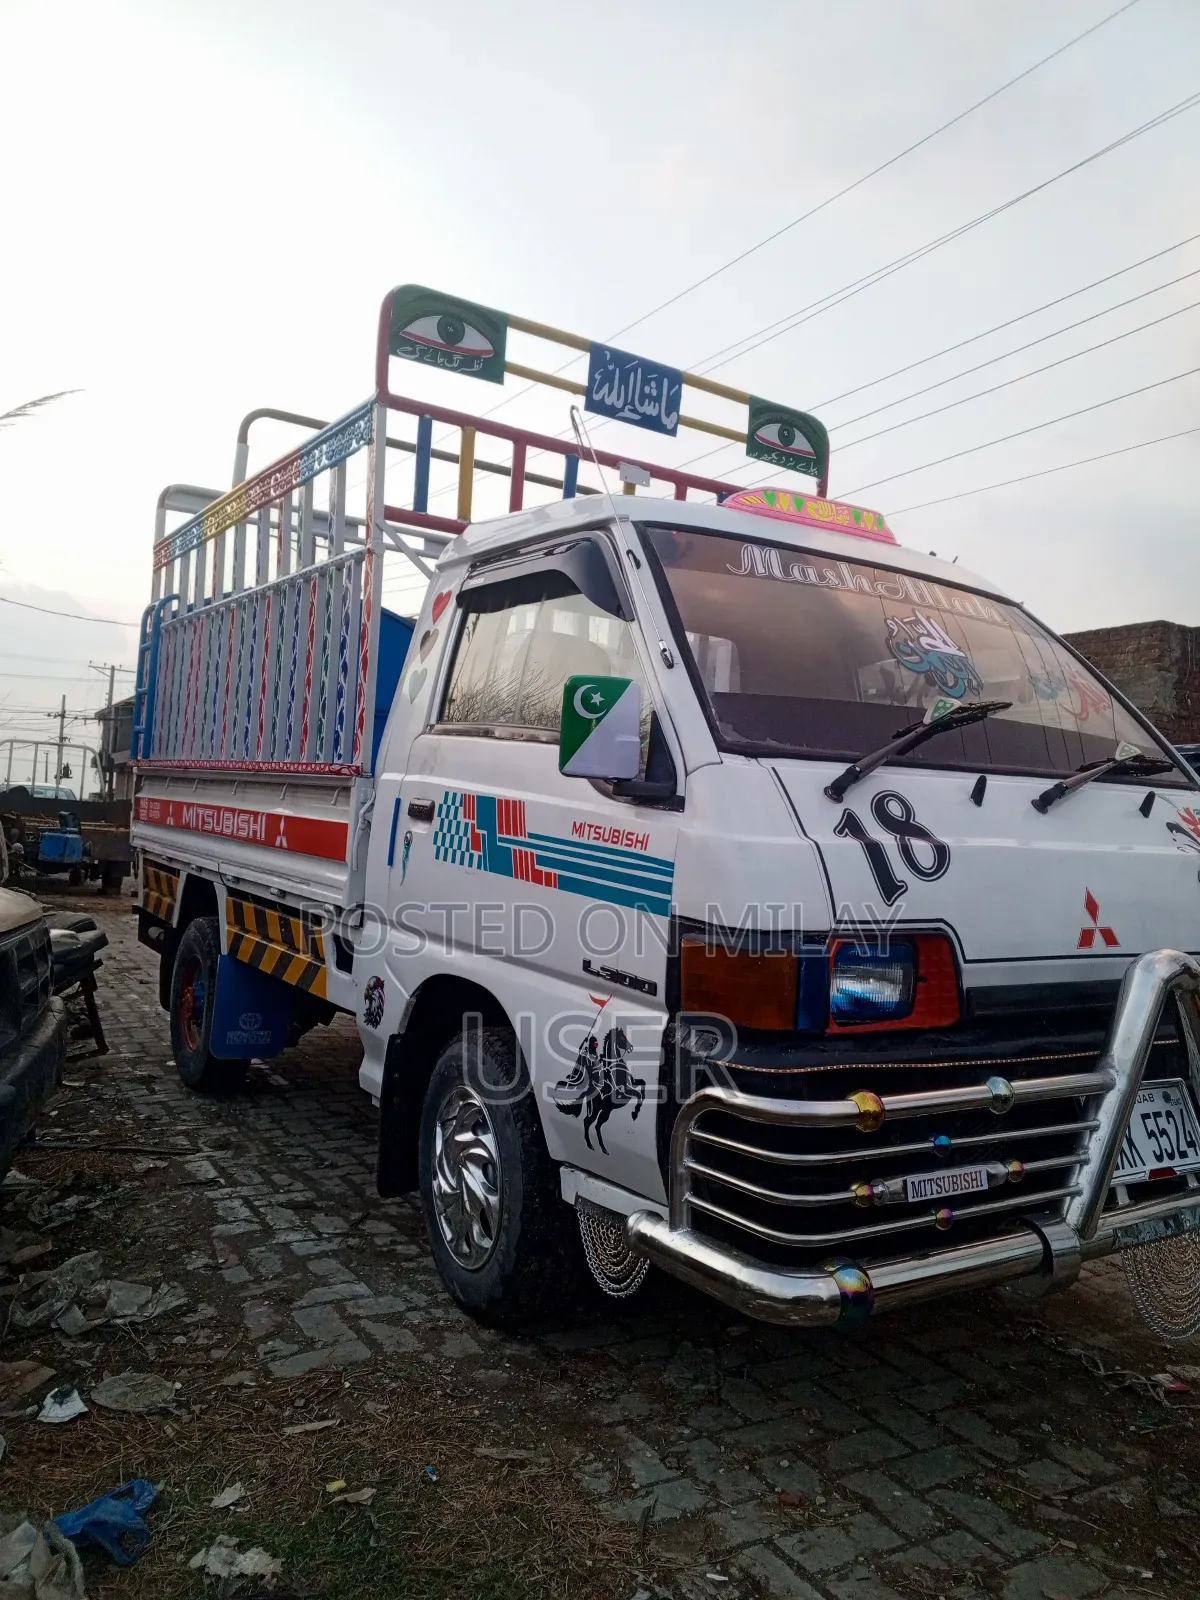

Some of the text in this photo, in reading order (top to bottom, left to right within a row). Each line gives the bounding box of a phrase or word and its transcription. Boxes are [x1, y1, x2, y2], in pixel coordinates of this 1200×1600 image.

[182, 804, 267, 841] MITSUBISHI
[571, 820, 651, 852] MITSUBISHI
[833, 789, 951, 908] 18
[582, 957, 658, 997] L300
[1140, 1109, 1199, 1163] 5524
[910, 1170, 984, 1199] MITSUBISHI
